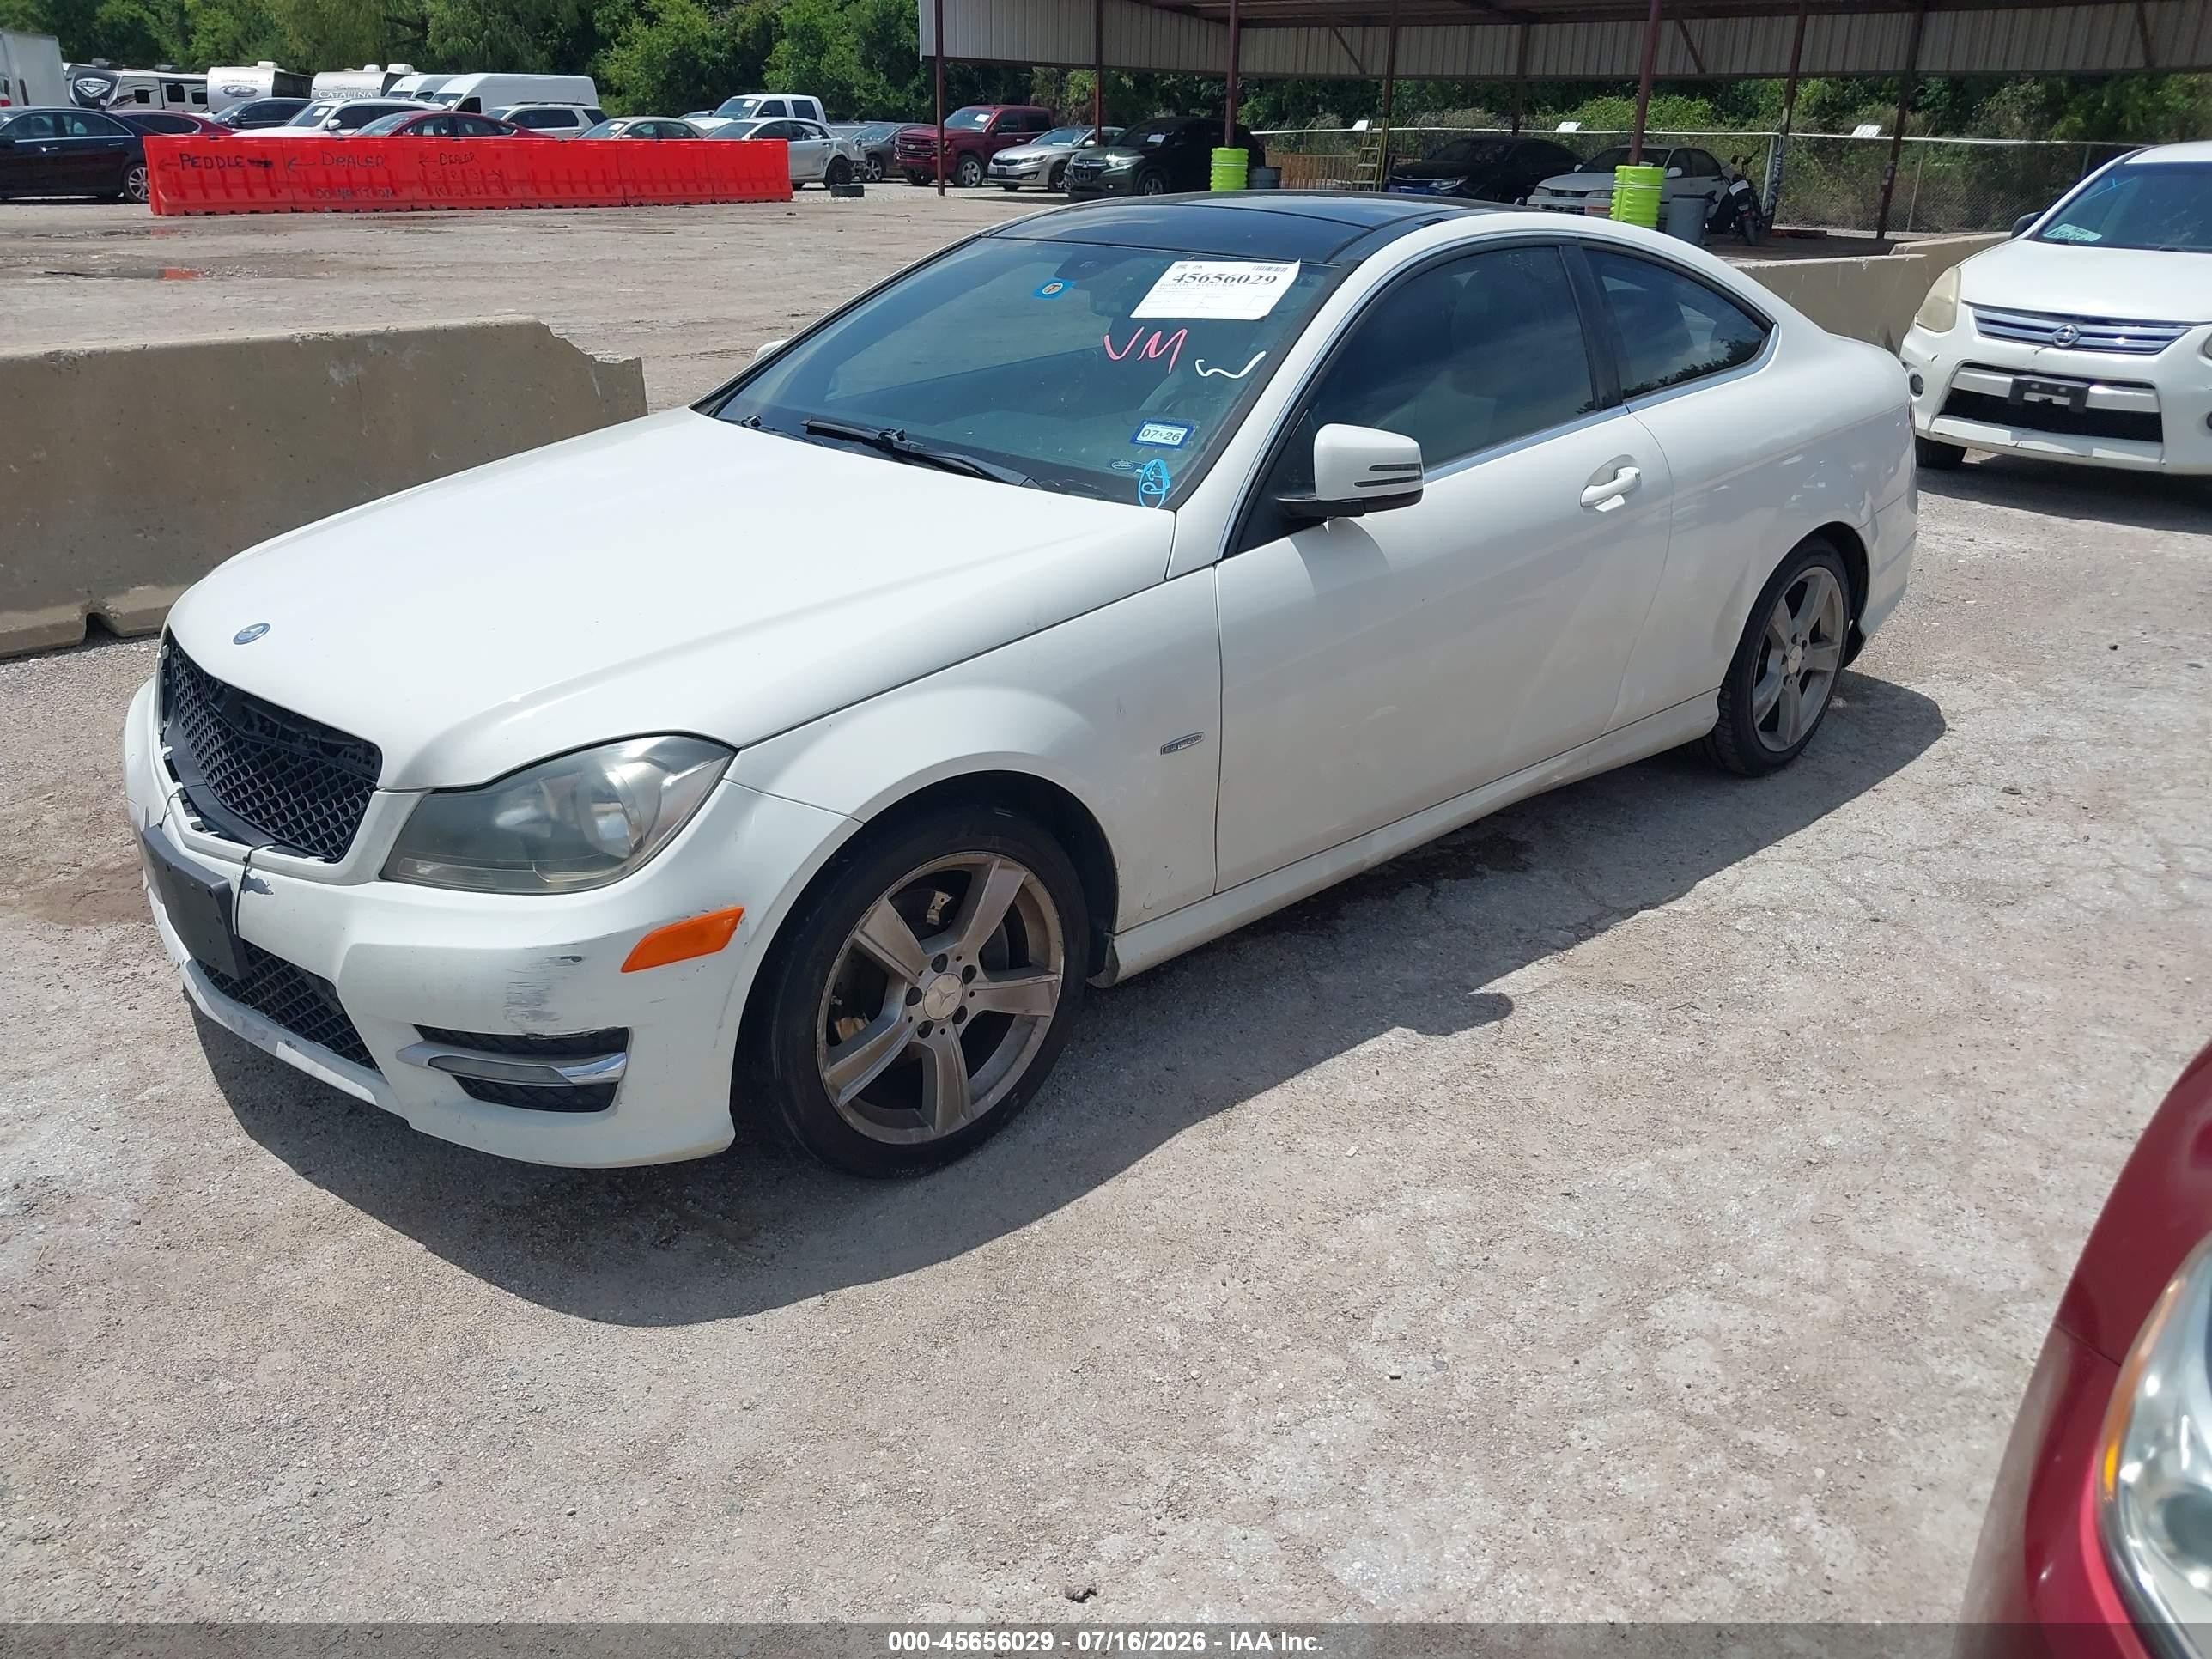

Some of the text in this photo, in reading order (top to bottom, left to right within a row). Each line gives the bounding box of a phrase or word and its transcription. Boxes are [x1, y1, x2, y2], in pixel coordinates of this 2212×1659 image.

[179, 152, 246, 172] PEDDLE
[1173, 273, 1278, 285] 45656029
[1103, 326, 1188, 374] VM
